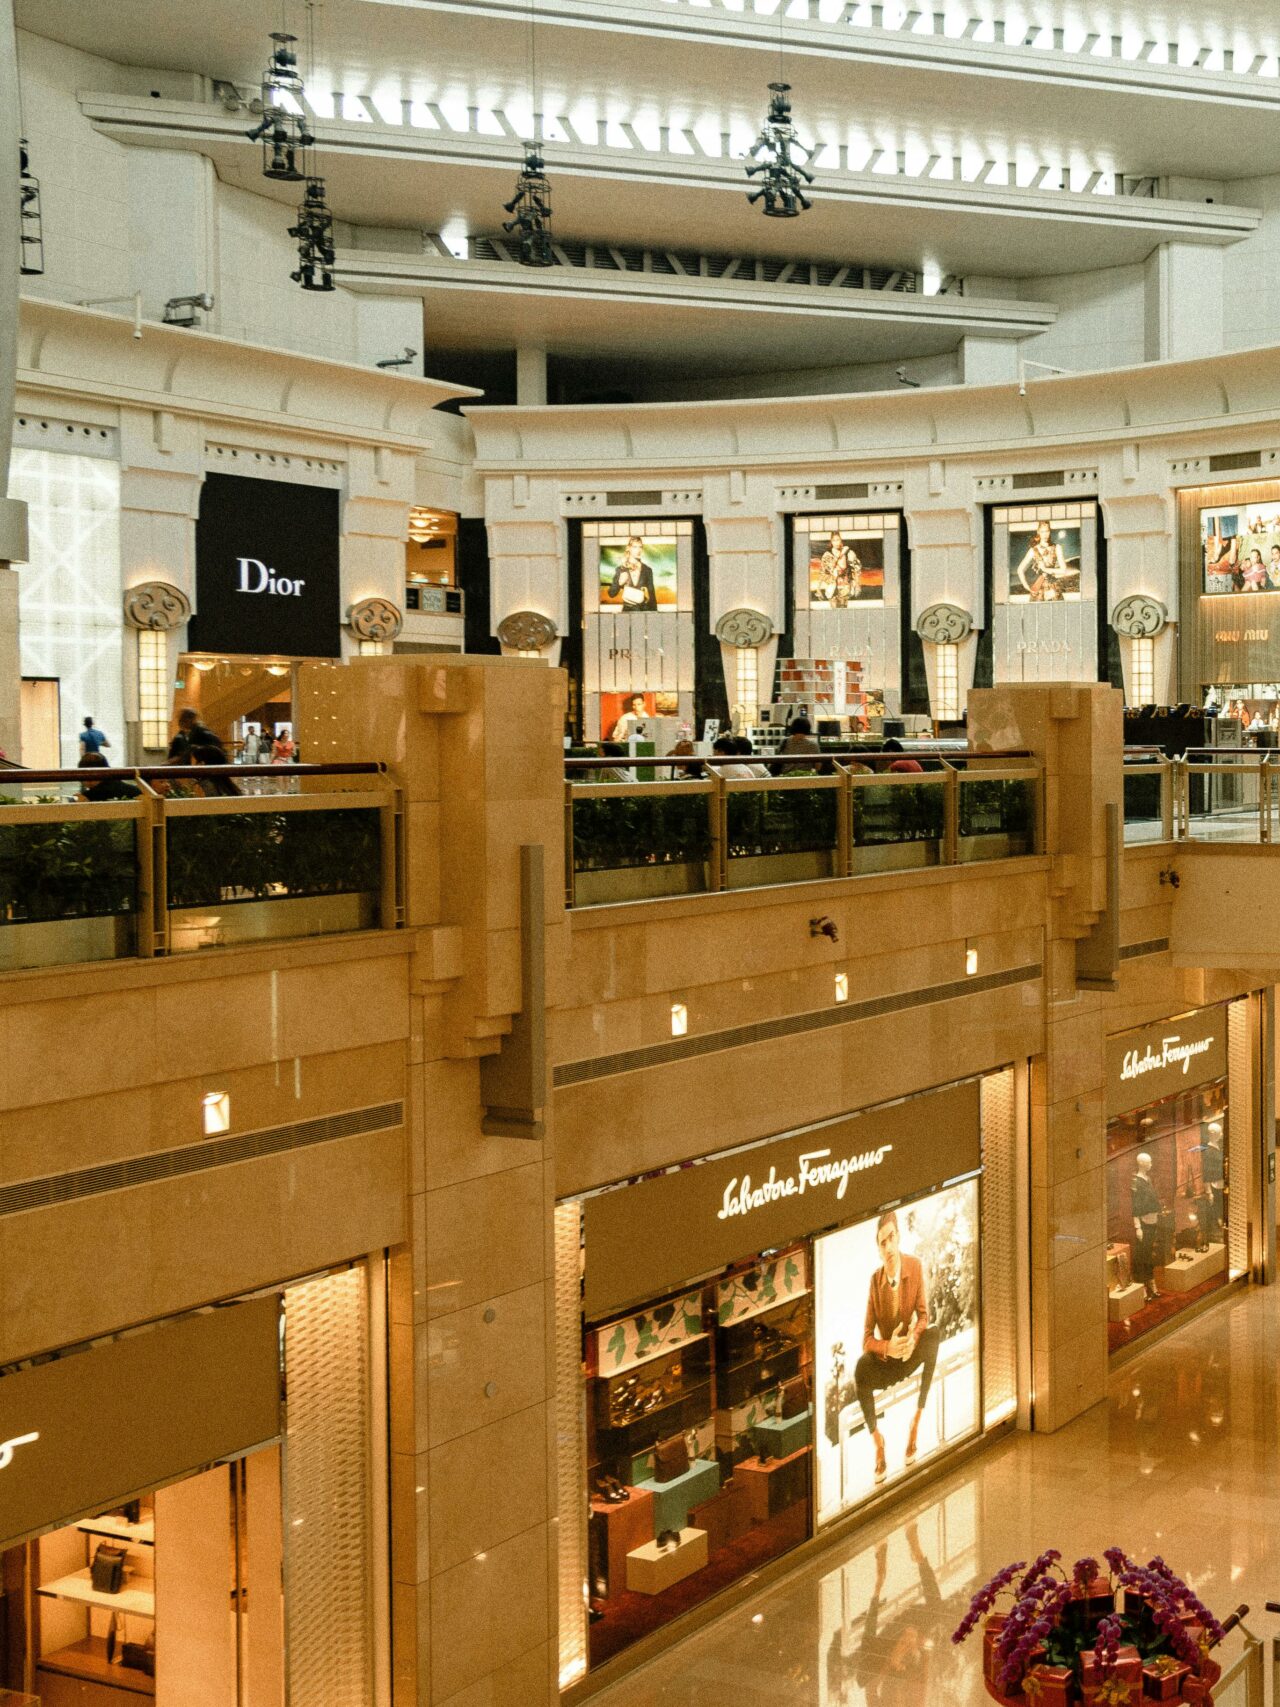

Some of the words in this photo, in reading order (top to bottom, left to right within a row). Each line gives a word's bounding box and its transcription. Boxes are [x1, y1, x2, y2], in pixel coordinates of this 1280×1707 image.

[236, 557, 306, 597] Dior
[1120, 1044, 1163, 1080] Salvatore
[1161, 1035, 1214, 1075] Ferragamo
[717, 1166, 799, 1220] Salvatore
[797, 1144, 893, 1200] Ferragamo
